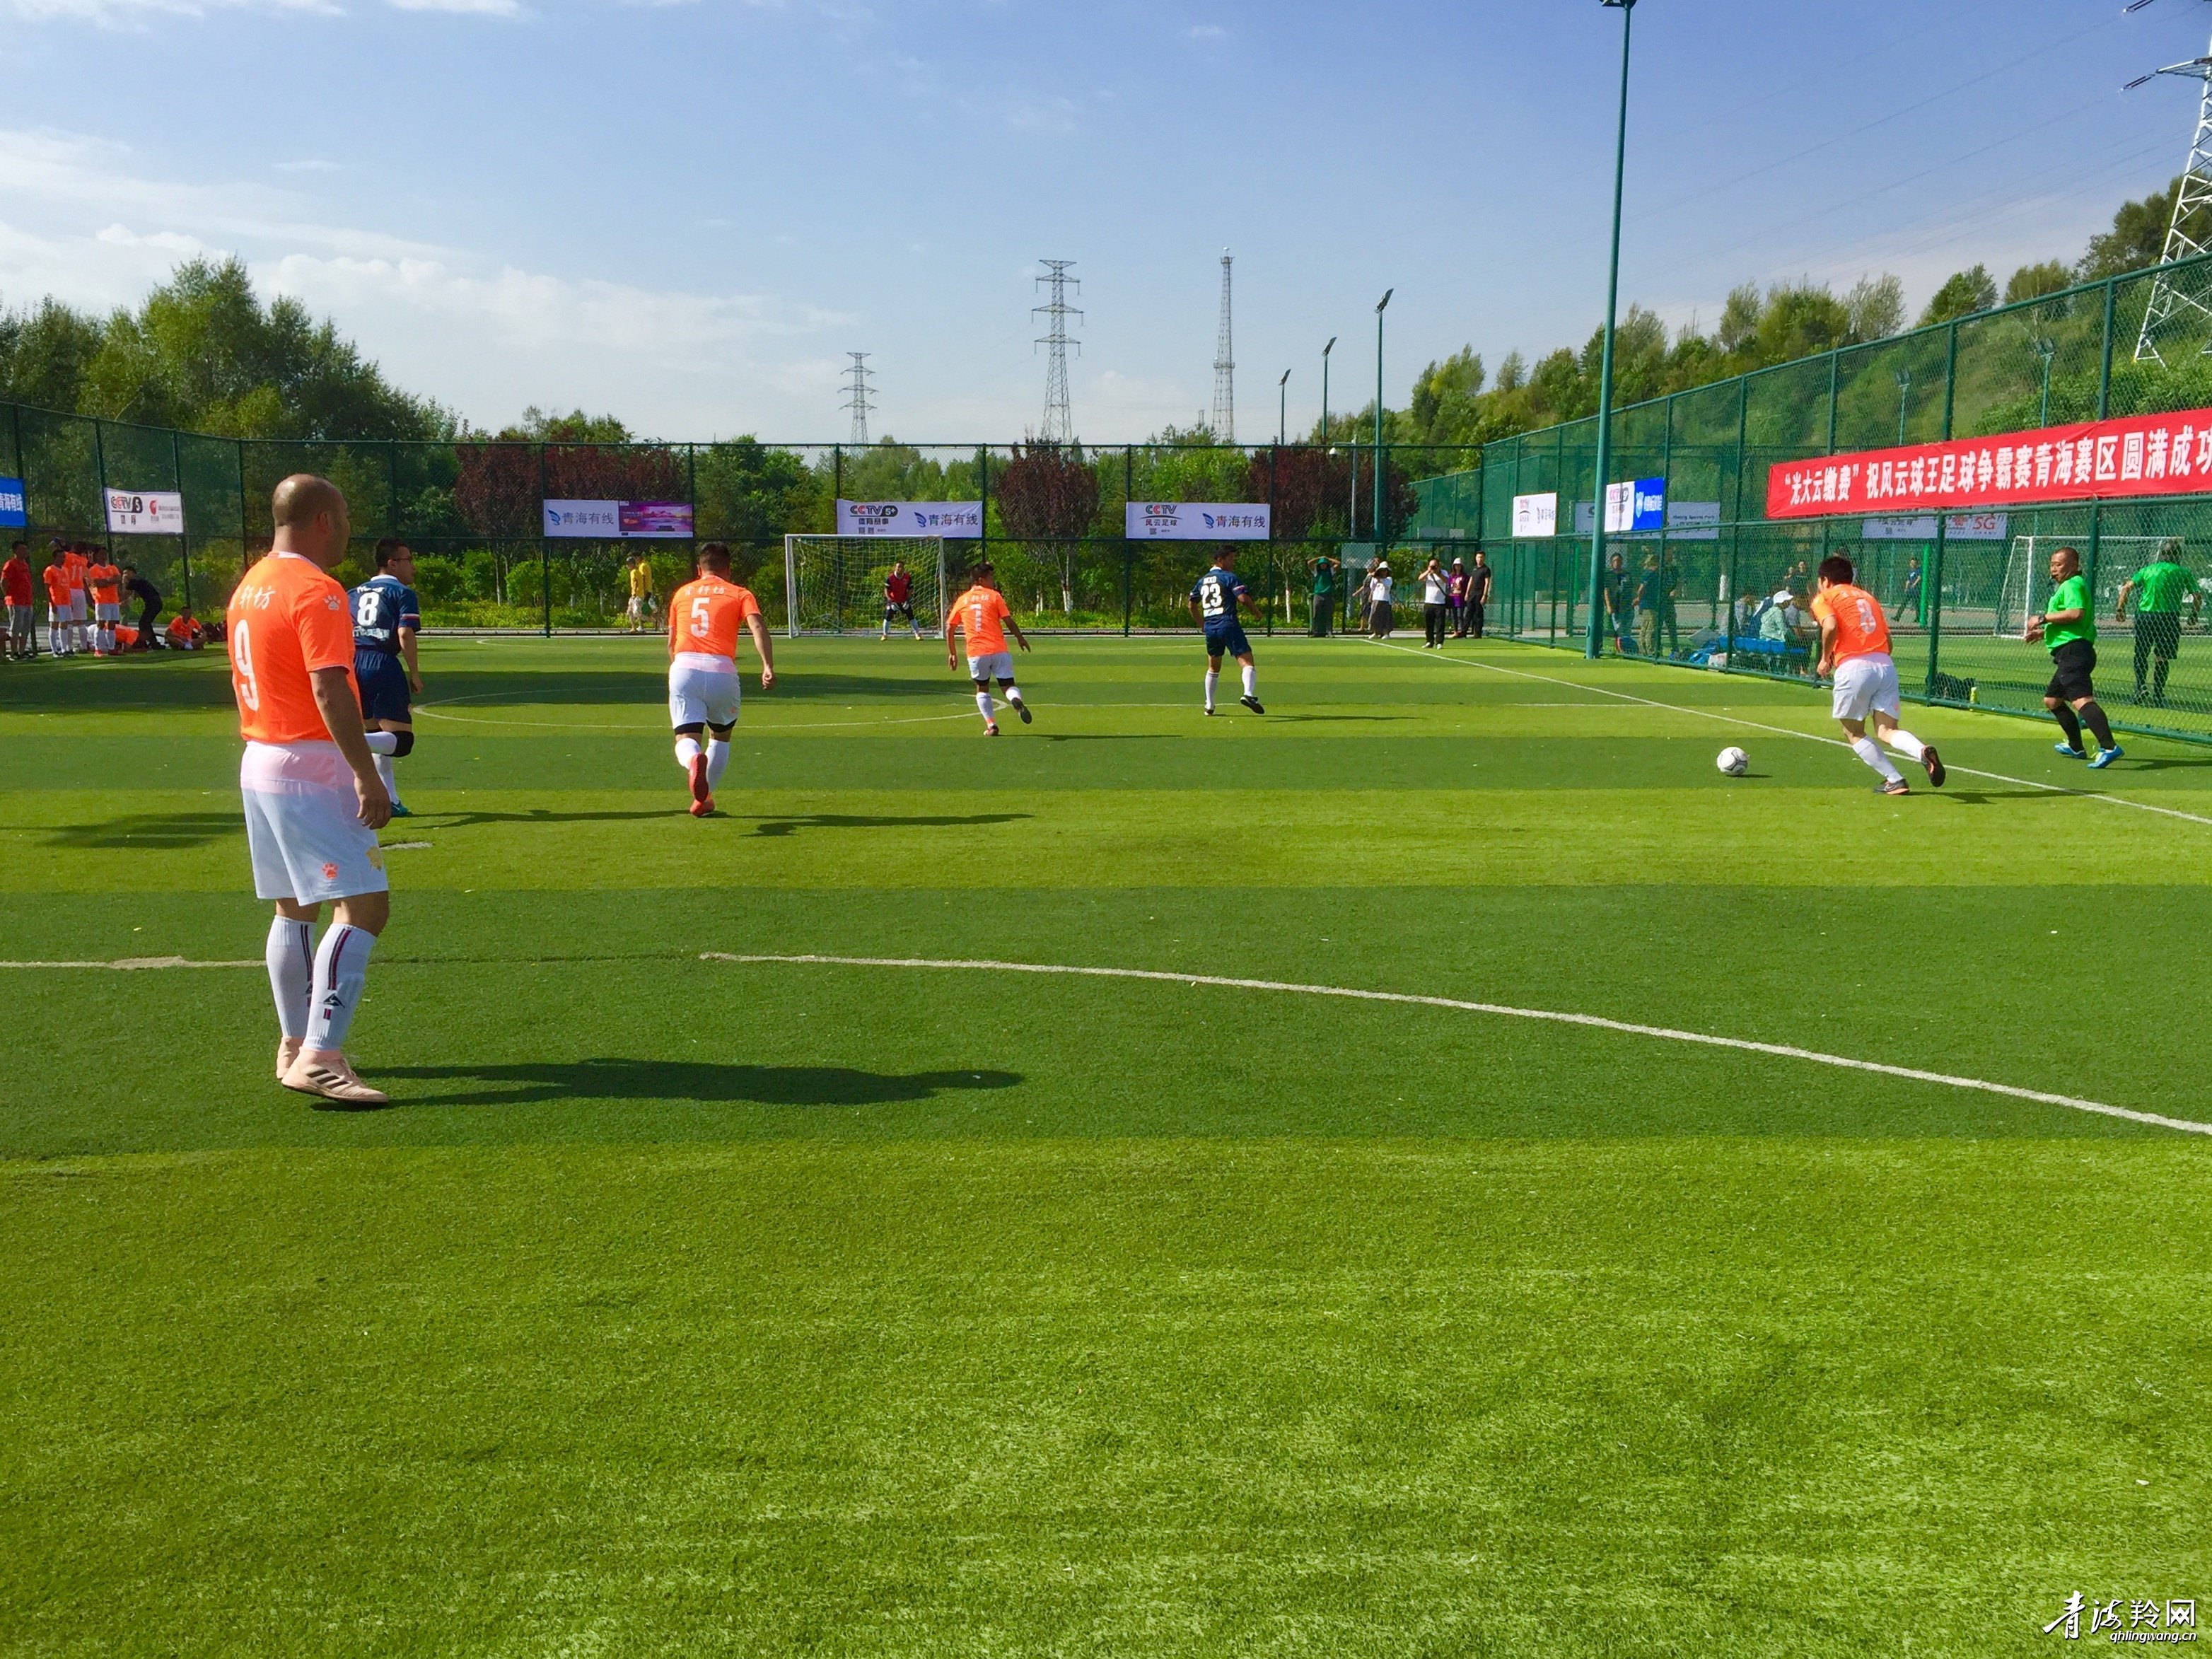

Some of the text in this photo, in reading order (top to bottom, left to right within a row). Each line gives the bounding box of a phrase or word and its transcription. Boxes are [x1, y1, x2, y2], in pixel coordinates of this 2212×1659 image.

[1146, 505, 1177, 514] CCTV
[562, 511, 615, 525] 青海有线
[929, 513, 979, 526] 青海有线
[1145, 518, 1177, 527] 风云足球
[1216, 515, 1266, 528] 青海有线
[1200, 583, 1223, 609] 23
[357, 592, 380, 627] 8
[690, 597, 710, 637] 5
[234, 619, 260, 711] 9
